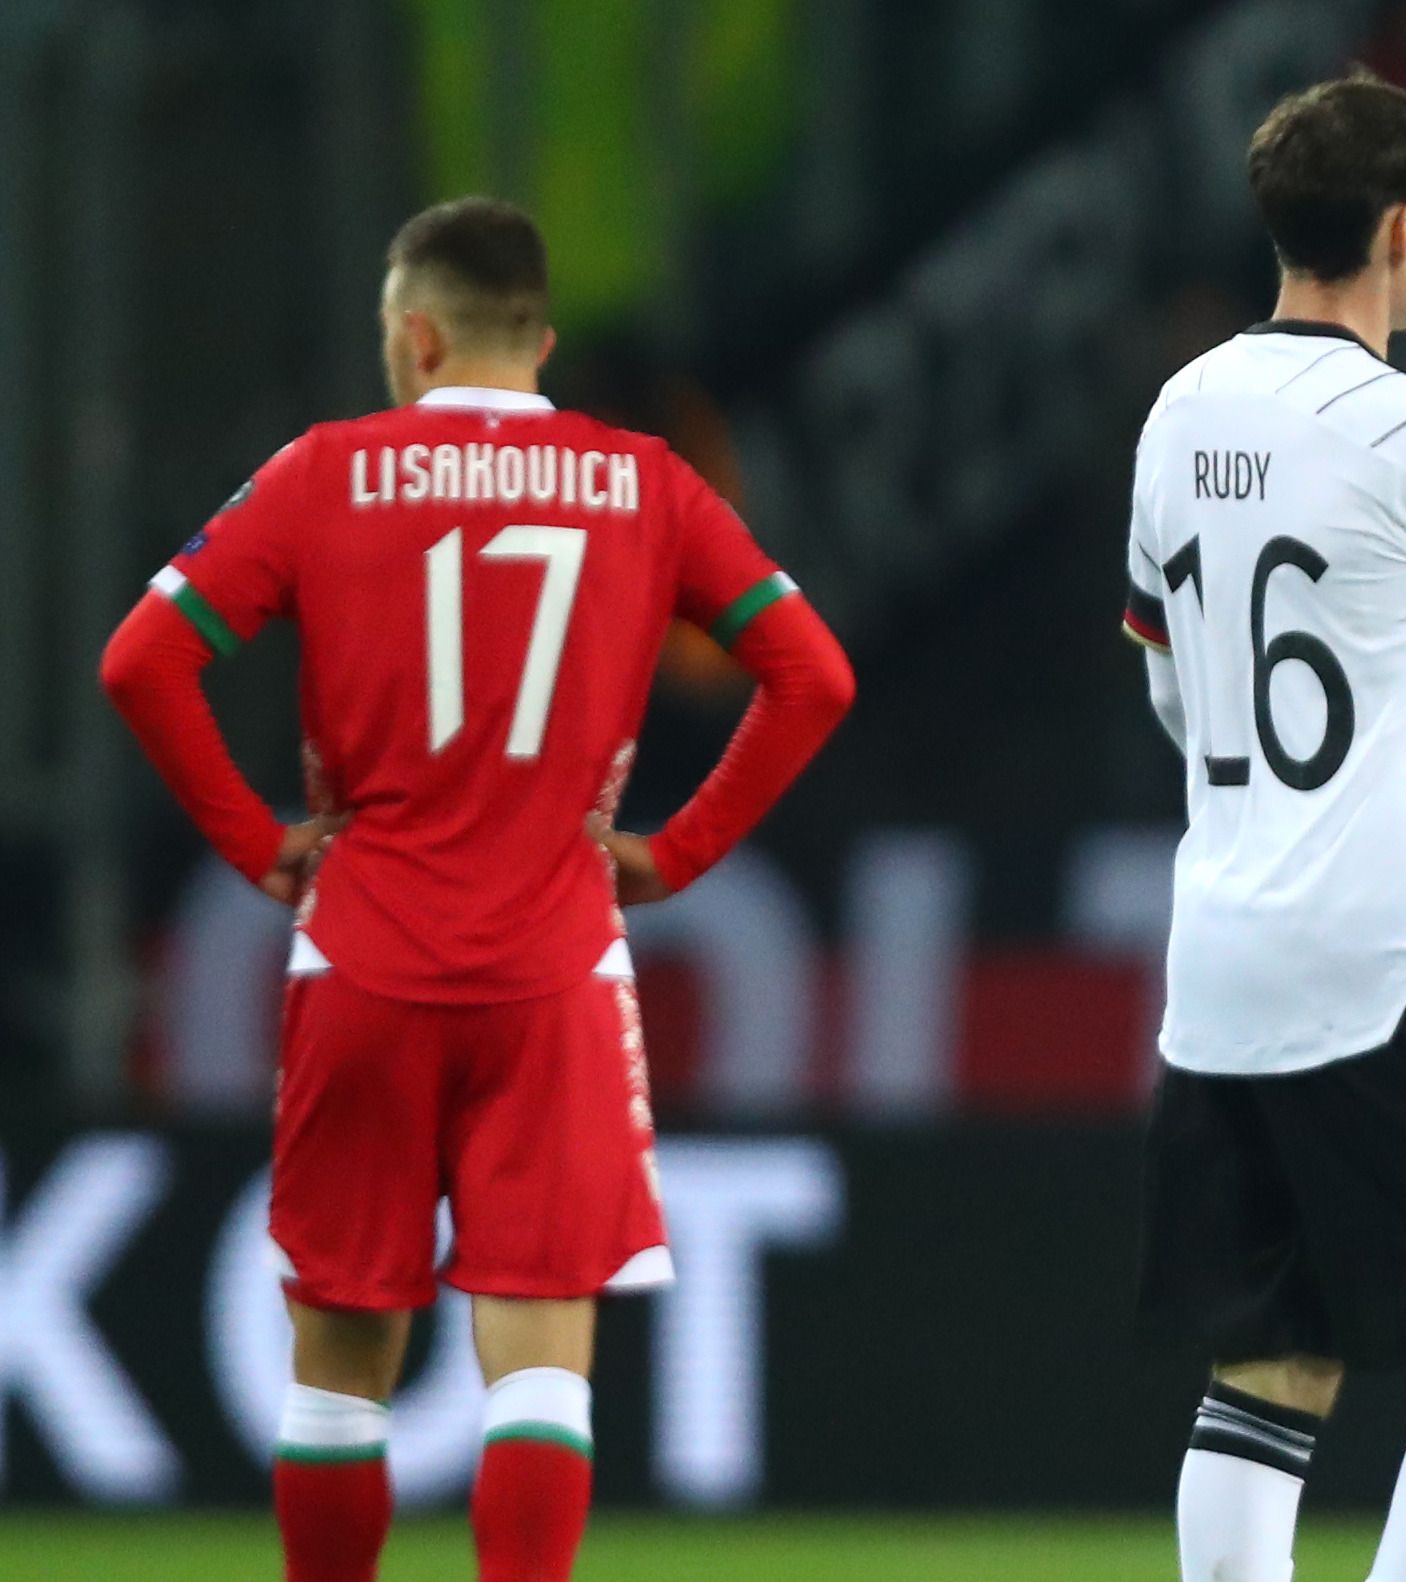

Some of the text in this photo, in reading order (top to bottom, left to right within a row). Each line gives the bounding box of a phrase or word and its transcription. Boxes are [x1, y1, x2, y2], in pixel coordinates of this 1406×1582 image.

[1194, 450, 1271, 500] RUDY
[423, 524, 588, 758] 17
[1162, 533, 1355, 791] 16
